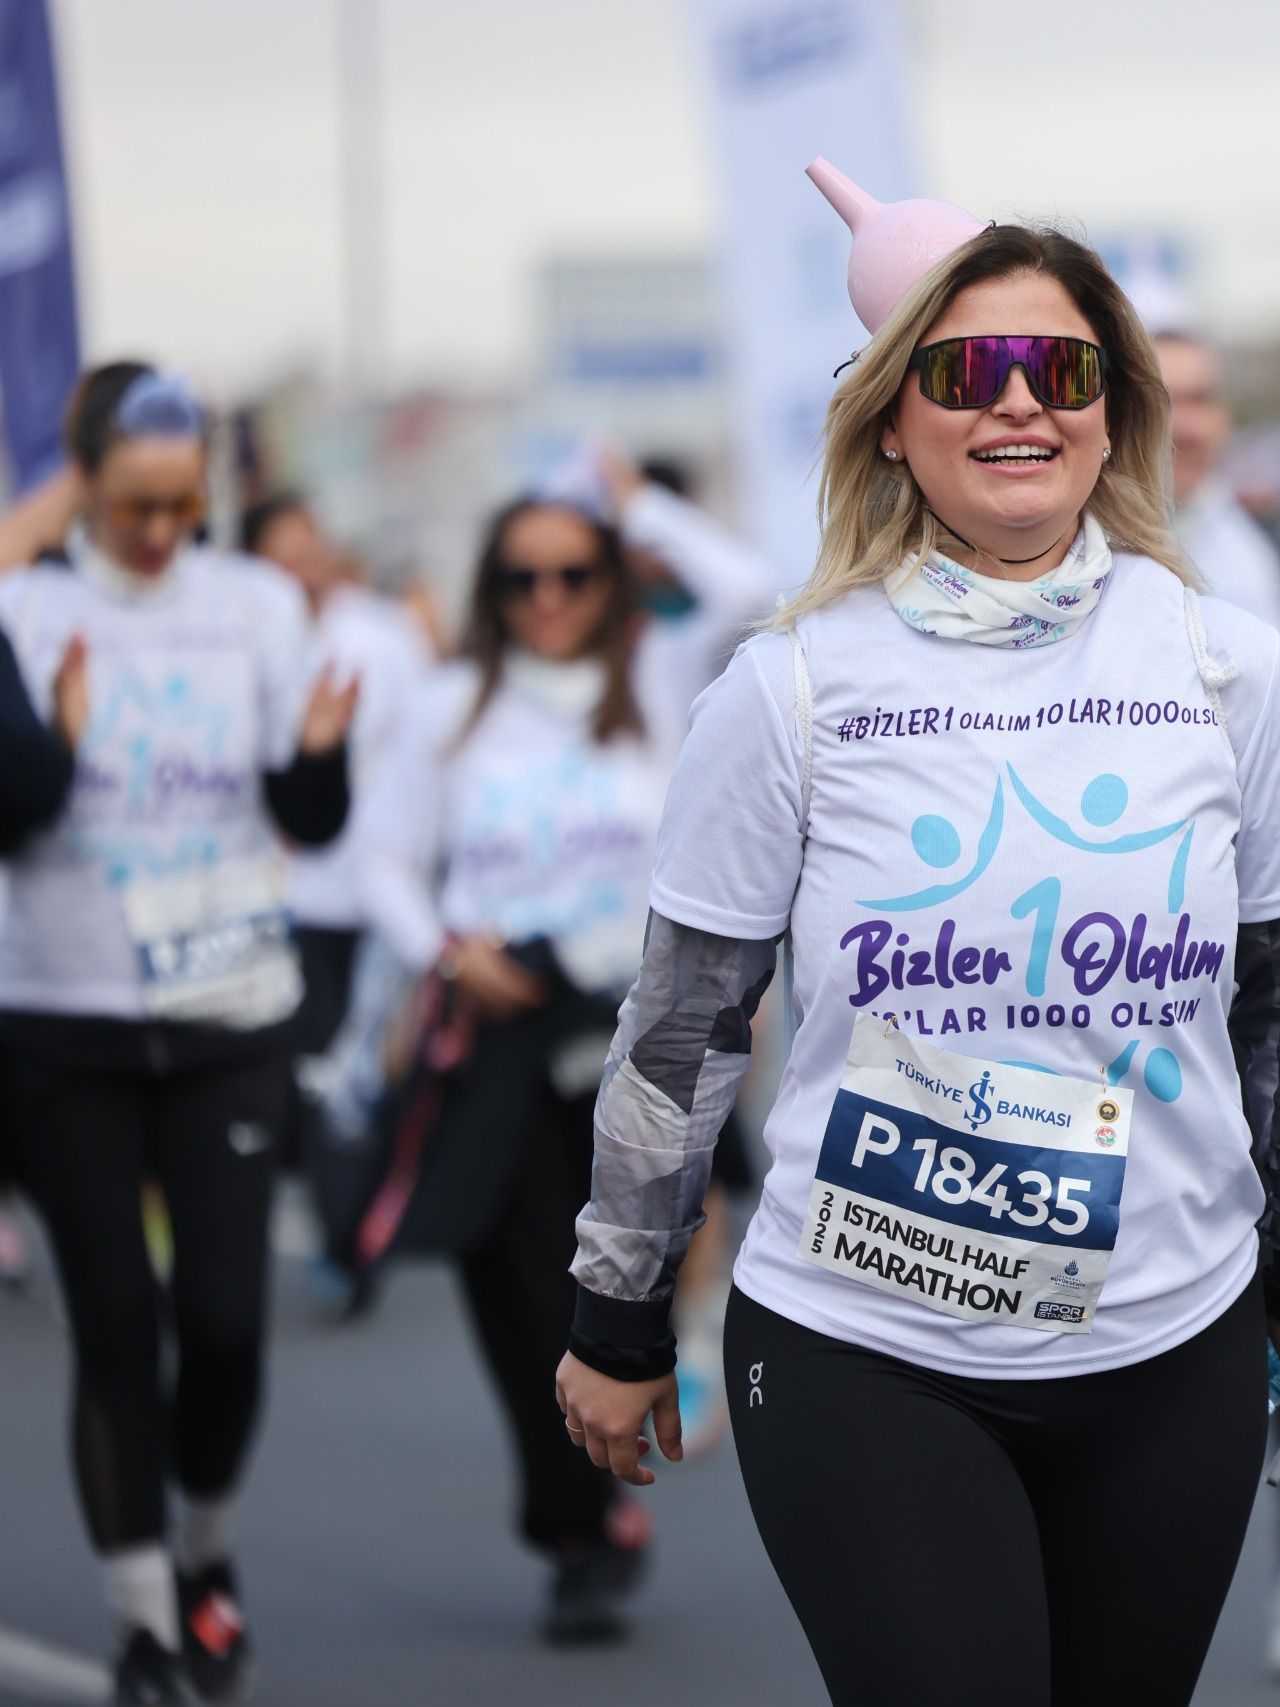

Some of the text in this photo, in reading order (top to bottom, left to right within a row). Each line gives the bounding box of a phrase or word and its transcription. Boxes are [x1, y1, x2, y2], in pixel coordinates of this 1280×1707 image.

[839, 876, 1226, 1007] Bizler 1 Olalım
[871, 1006, 988, 1036] 'LAR
[1111, 997, 1201, 1030] OLSUN
[895, 1059, 965, 1104] TÜRKİYE
[996, 1100, 1073, 1128] BANKASI
[850, 1111, 1092, 1236] P 18435
[833, 1232, 1023, 1315] MARATHON
[843, 1200, 1031, 1280] ISTANBUL HALF
[1038, 1303, 1081, 1317] SPOR
